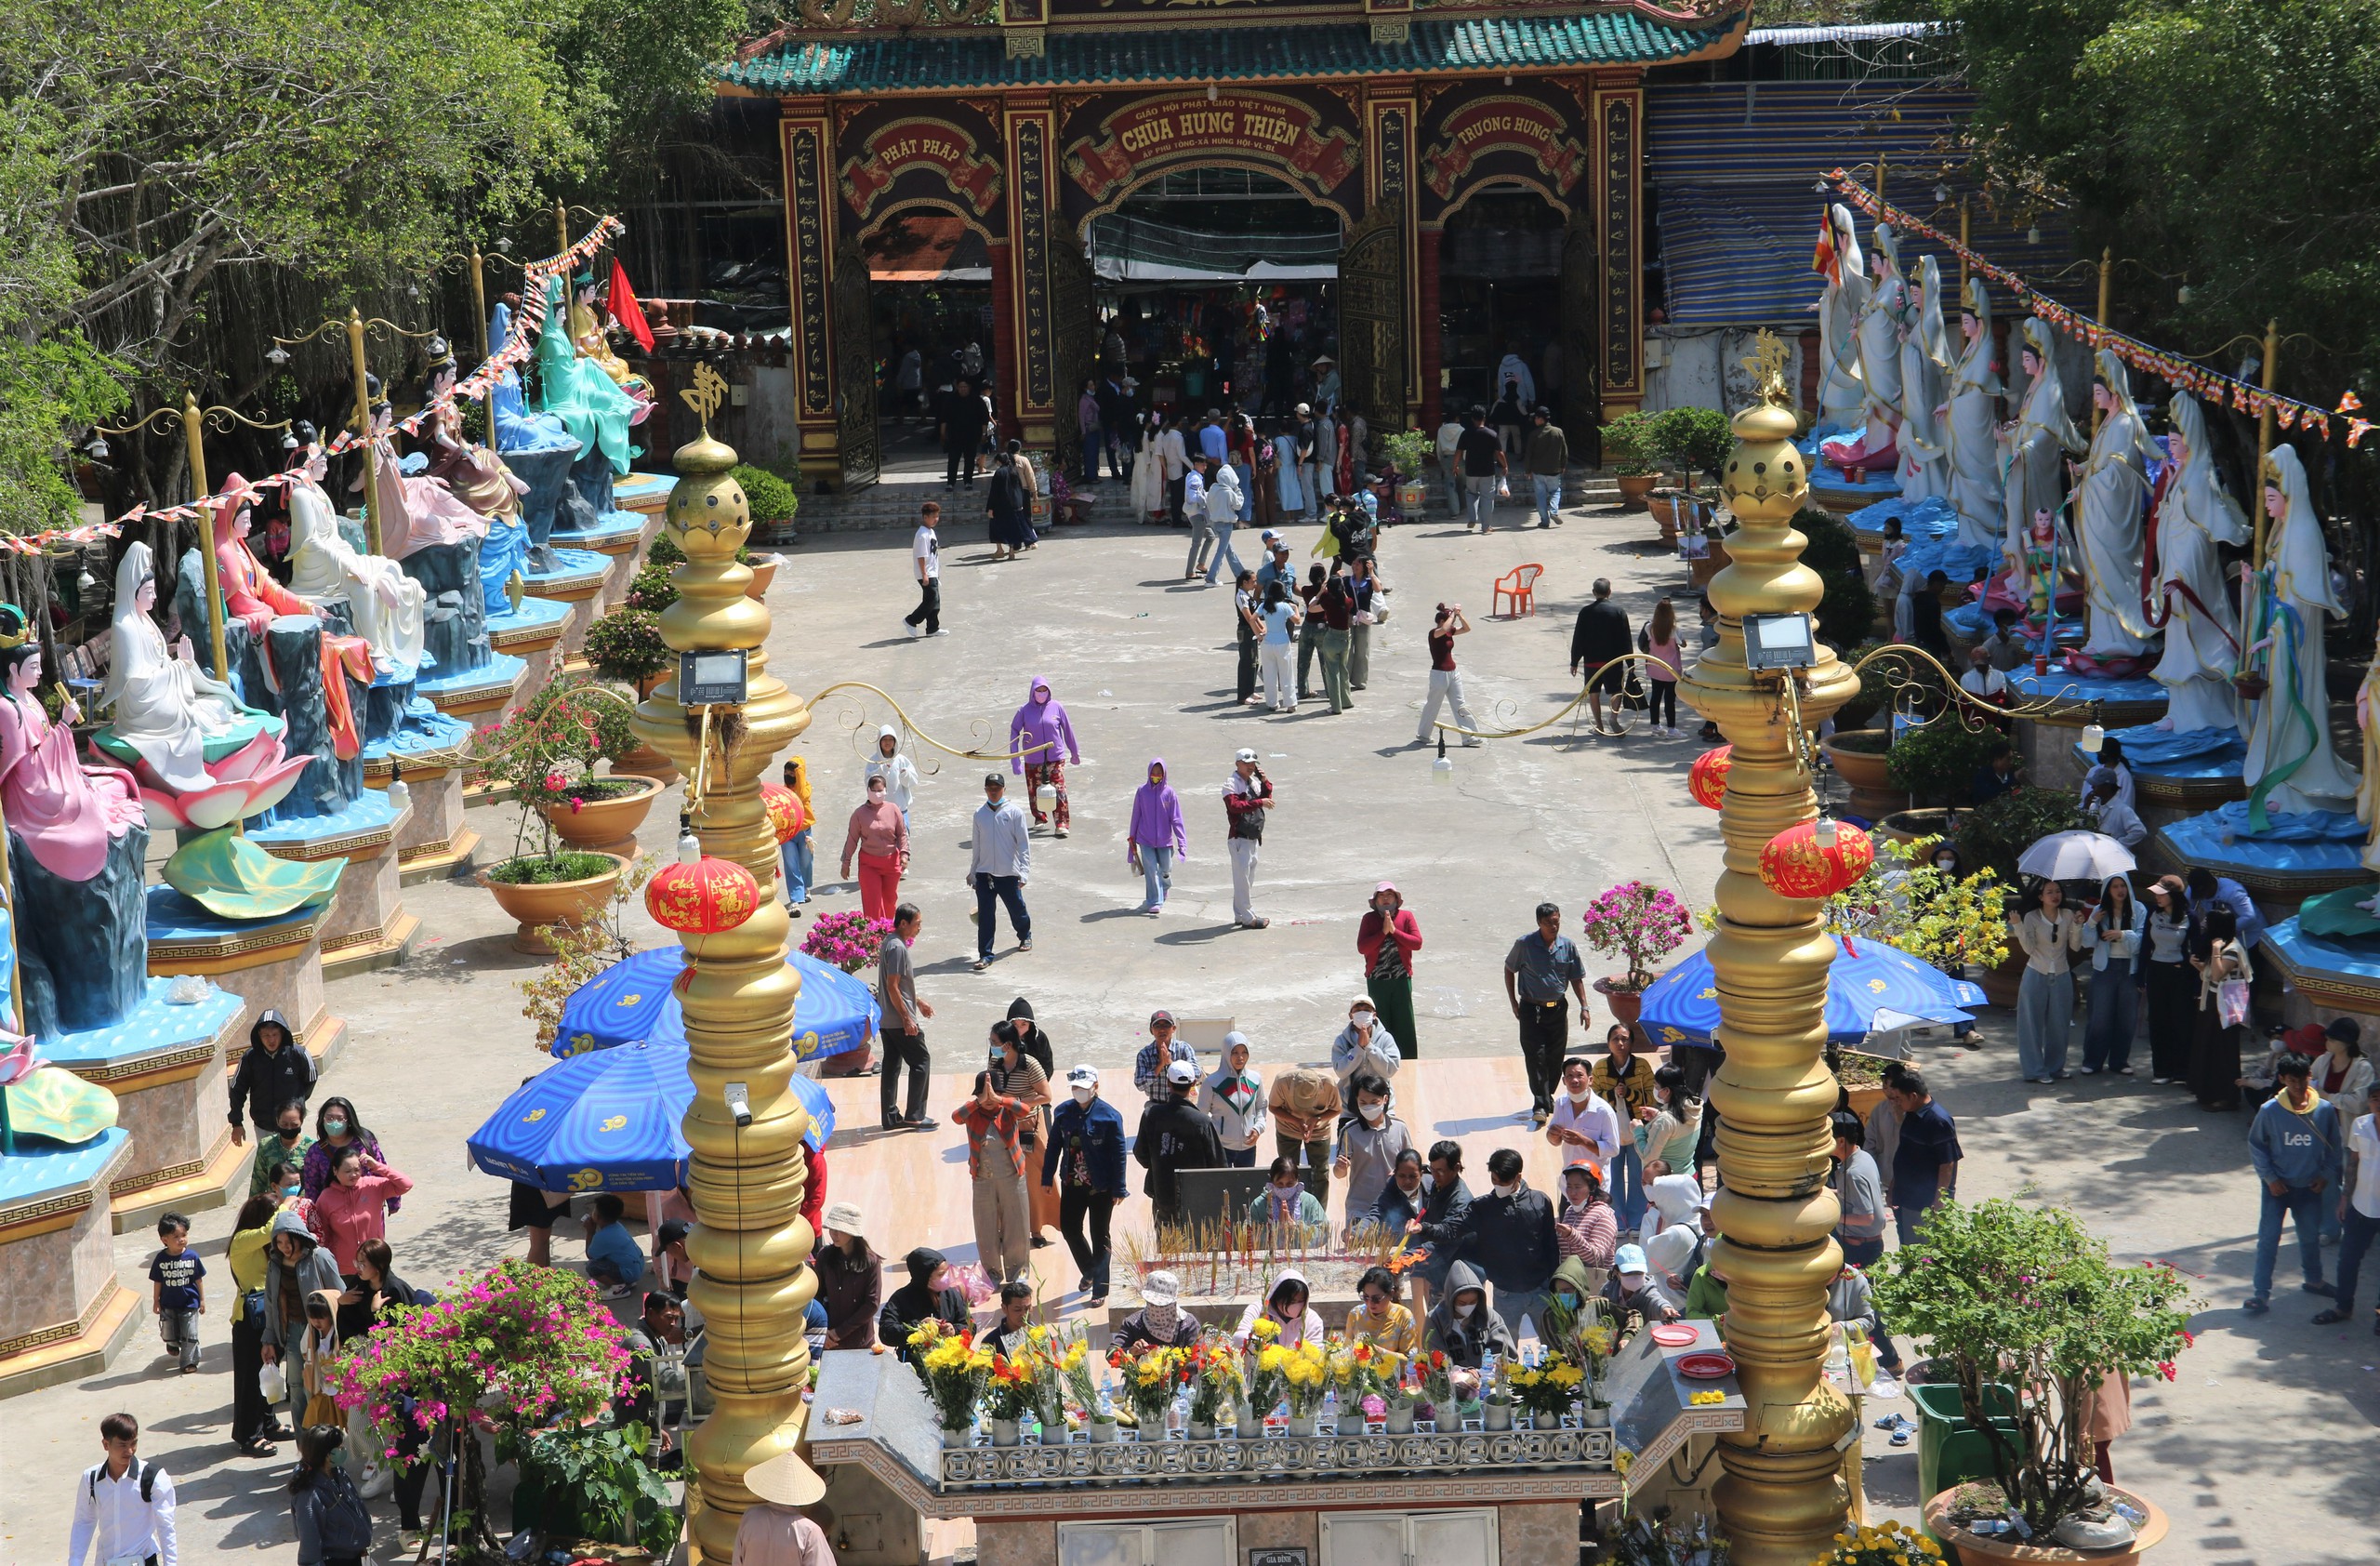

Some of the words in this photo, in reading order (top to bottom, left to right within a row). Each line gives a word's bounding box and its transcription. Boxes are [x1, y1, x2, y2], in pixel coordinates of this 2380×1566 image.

[1263, 103, 1287, 115] NAM
[2284, 1132, 2312, 1146] Lee
[566, 1167, 604, 1192] 30
[159, 1260, 194, 1269] original
